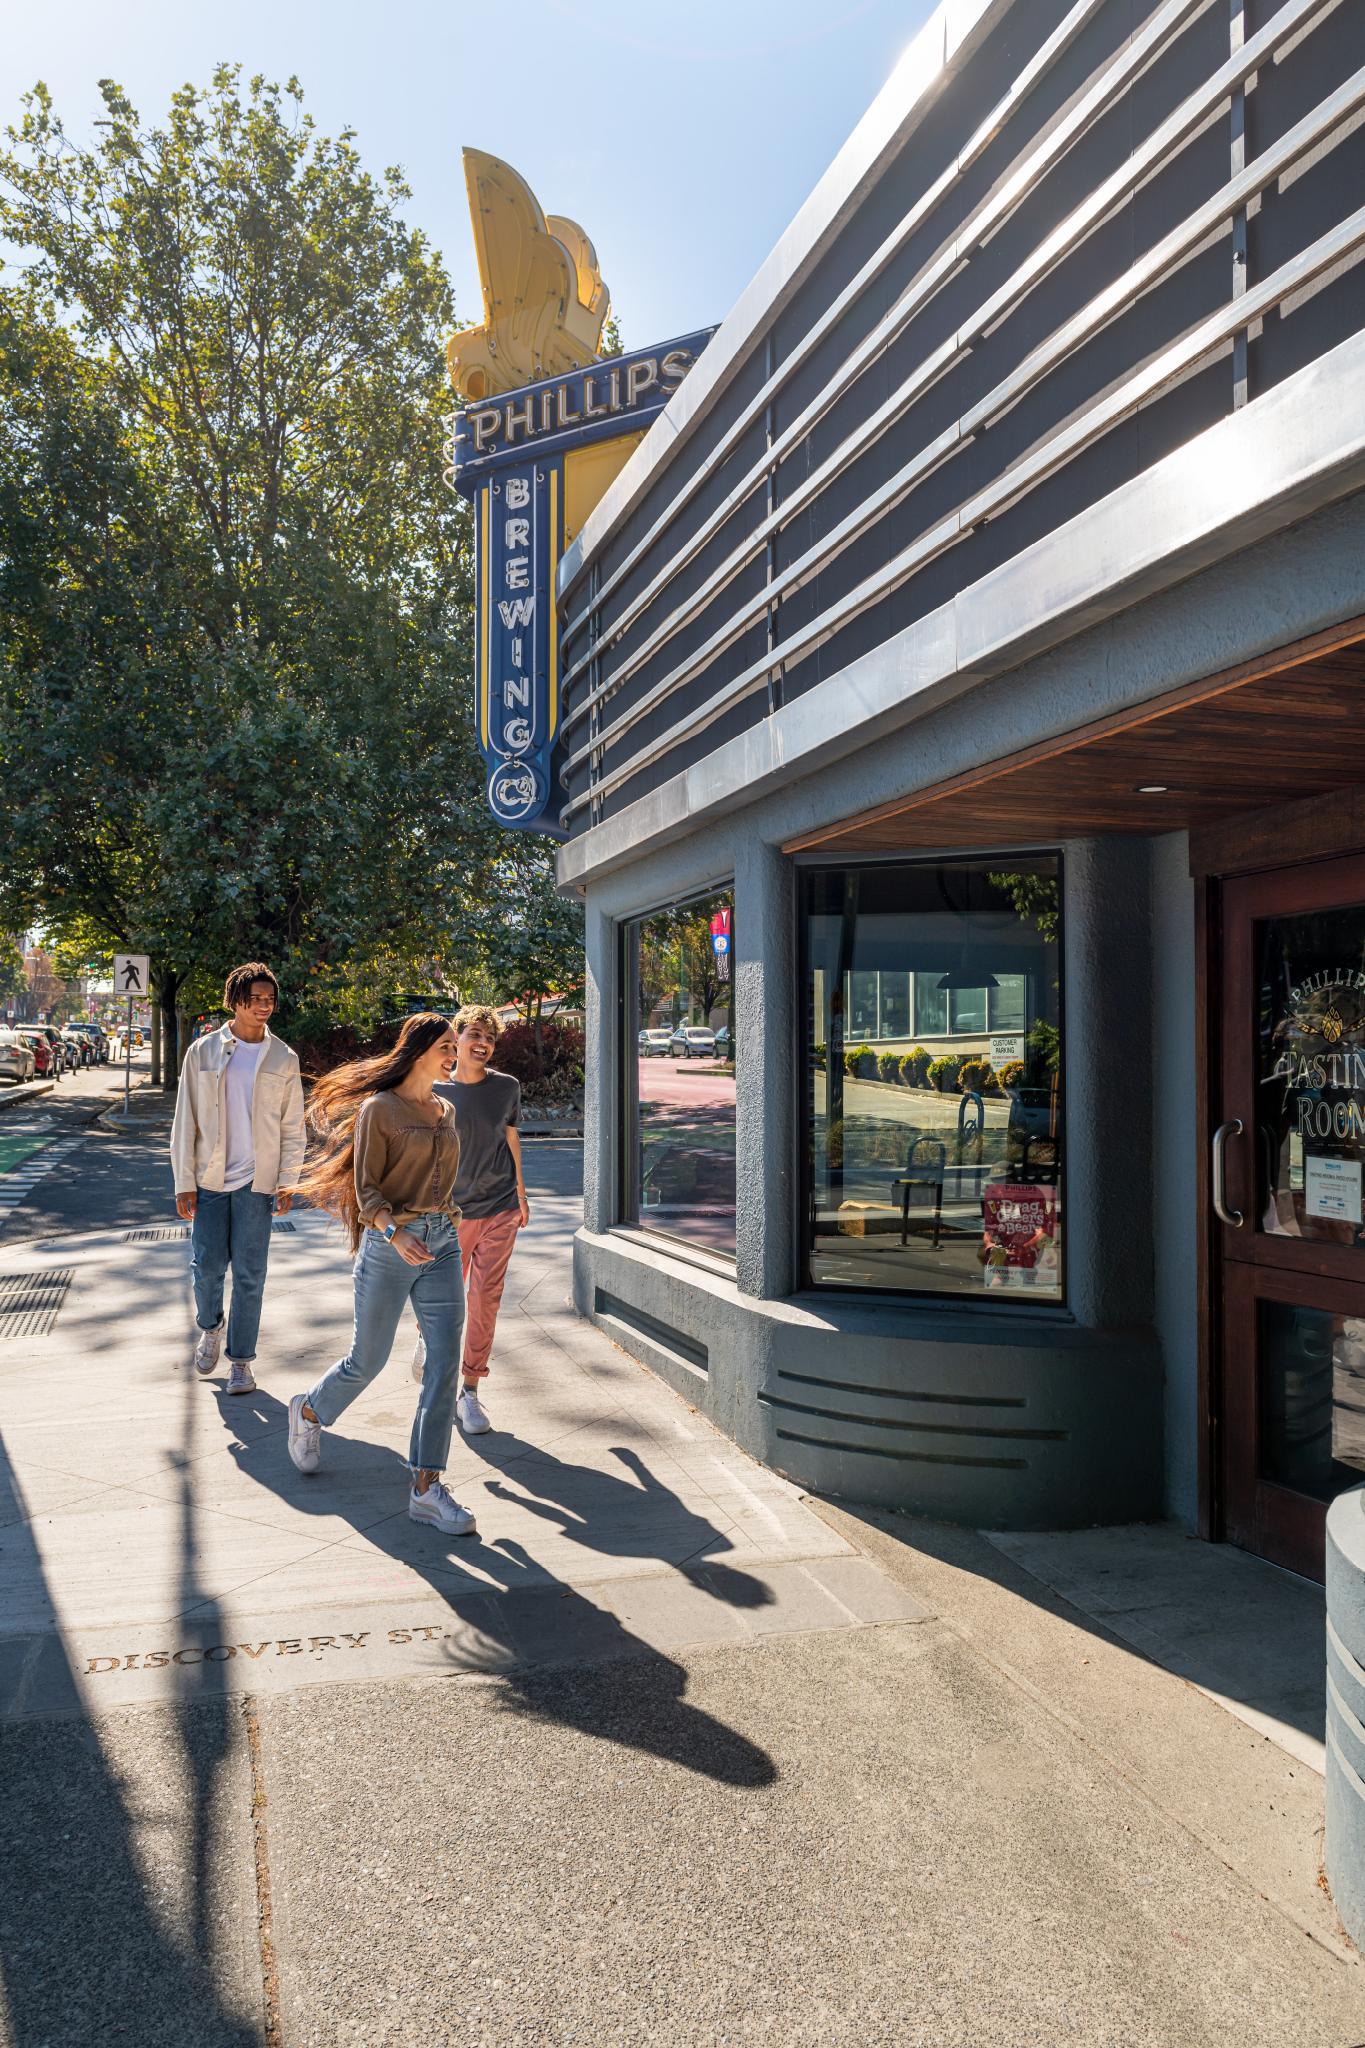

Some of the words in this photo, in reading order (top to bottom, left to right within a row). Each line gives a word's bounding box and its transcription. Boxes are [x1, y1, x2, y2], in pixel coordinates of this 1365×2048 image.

[467, 349, 693, 453] PHILLIPS
[498, 477, 536, 751] BREWING
[1291, 967, 1365, 1006] PHILLIP
[992, 1039, 1018, 1047] CUSTOMER
[1283, 1051, 1365, 1090] TASTIN
[84, 1631, 372, 1675] DISCOVERY
[387, 1625, 453, 1645] ST.
